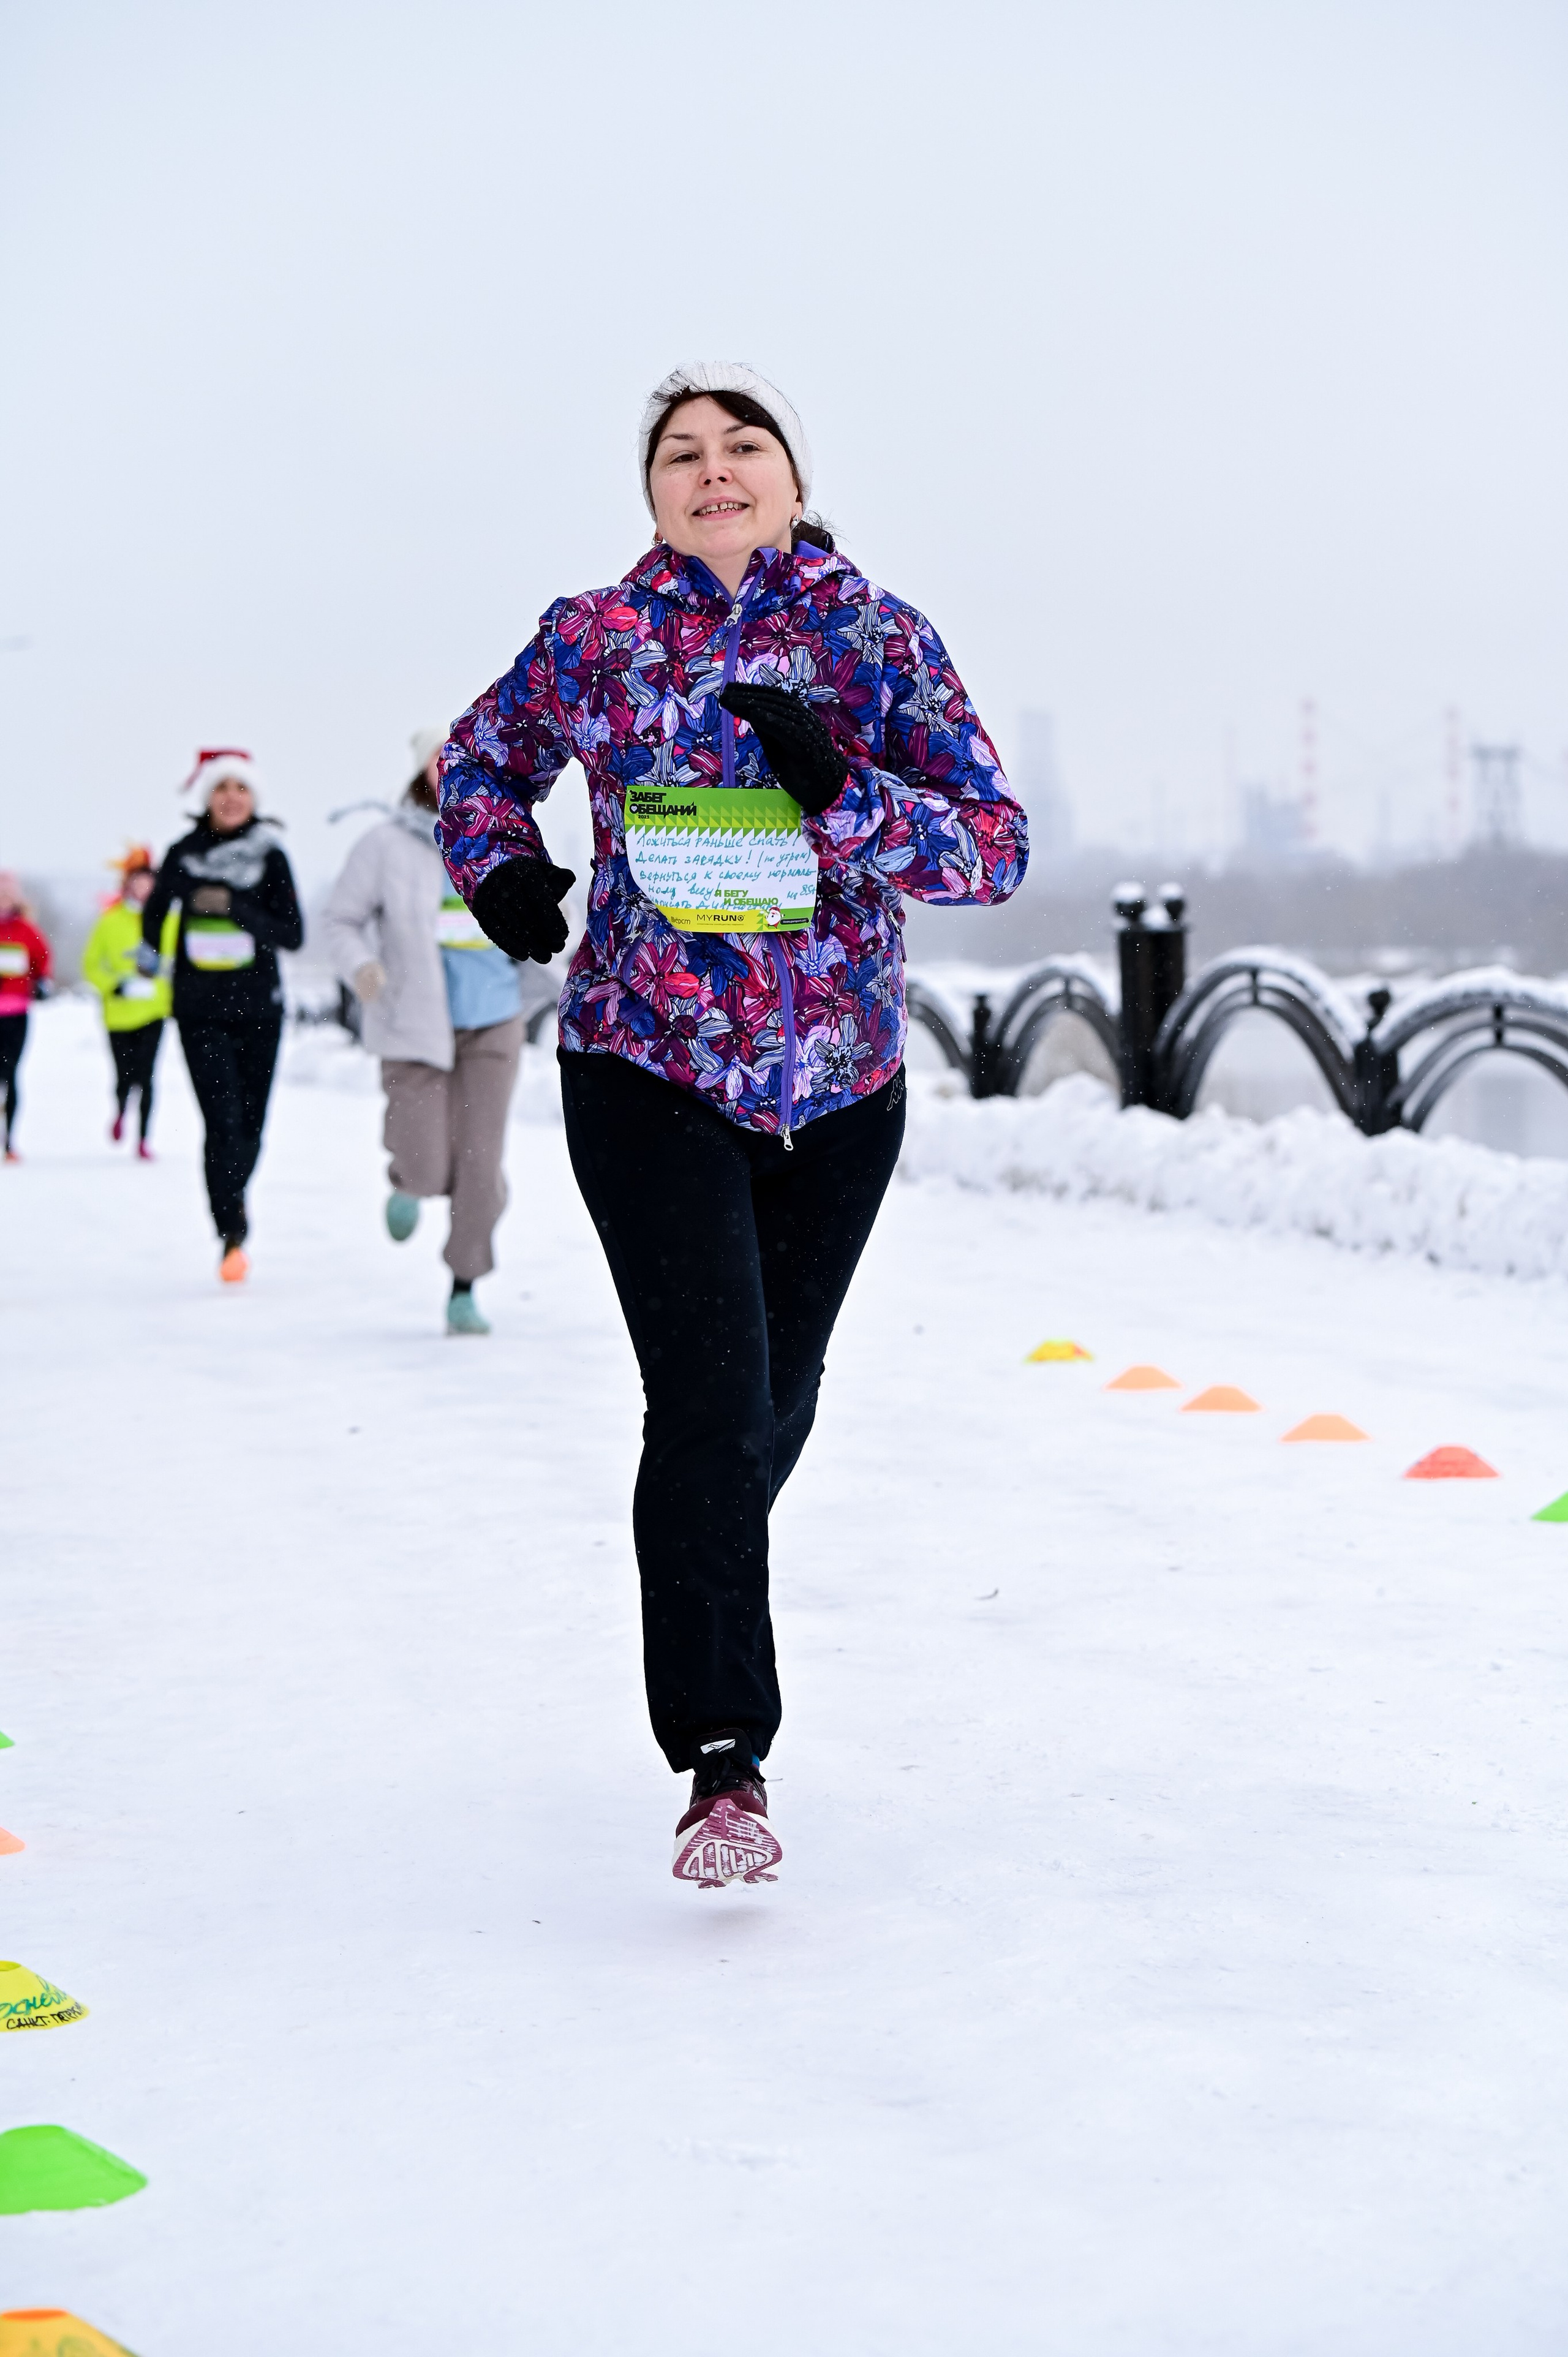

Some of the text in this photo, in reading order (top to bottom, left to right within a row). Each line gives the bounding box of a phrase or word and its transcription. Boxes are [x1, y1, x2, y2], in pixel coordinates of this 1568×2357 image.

[630, 791, 667, 802] ЗАБЕГ
[629, 801, 697, 819] ОБЕЩАНИЙ
[733, 897, 779, 907] ОБЕЩАЮ
